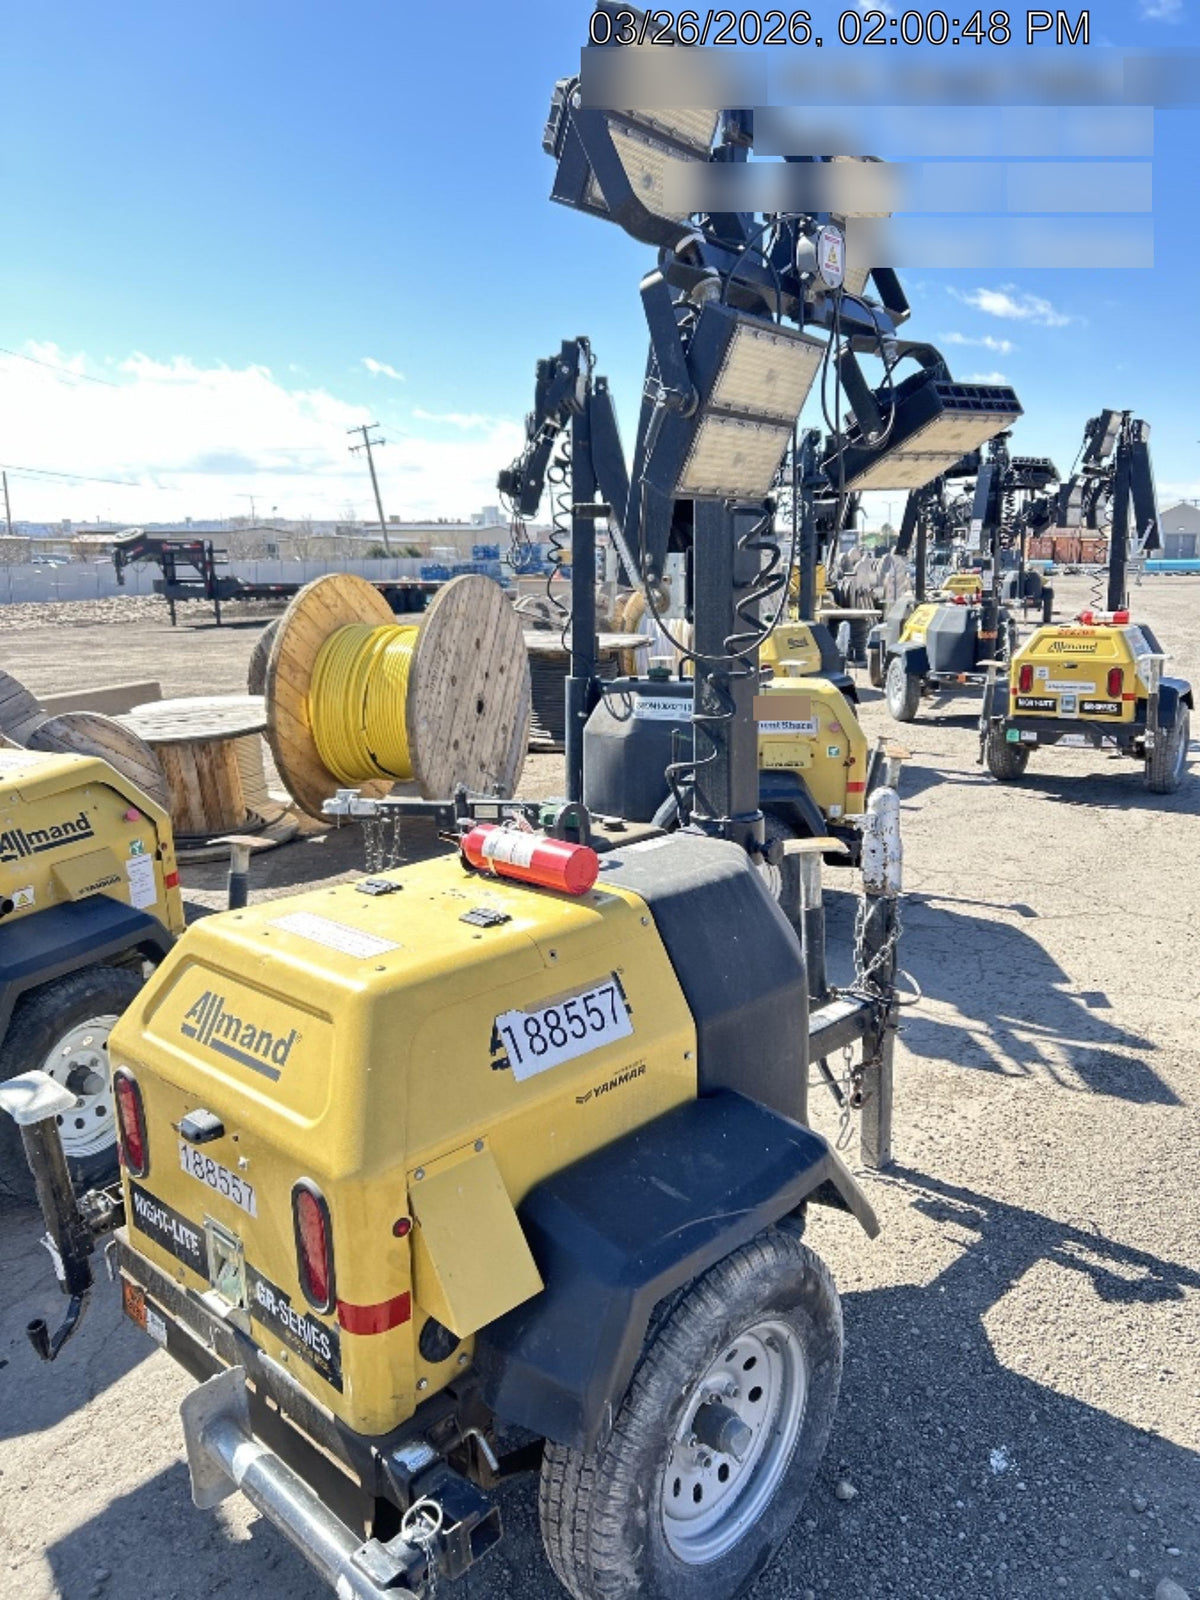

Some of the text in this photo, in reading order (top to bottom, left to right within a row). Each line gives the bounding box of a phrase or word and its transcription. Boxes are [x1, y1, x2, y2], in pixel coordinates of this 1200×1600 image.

[0, 811, 92, 856] Allmand
[183, 990, 297, 1068] Allmand
[502, 985, 619, 1064] 188557
[593, 1064, 647, 1097] YANMAR
[181, 1145, 255, 1211] 188557
[134, 1192, 199, 1252] NIGHT-LITE
[256, 1281, 332, 1360] GR-SERIES
